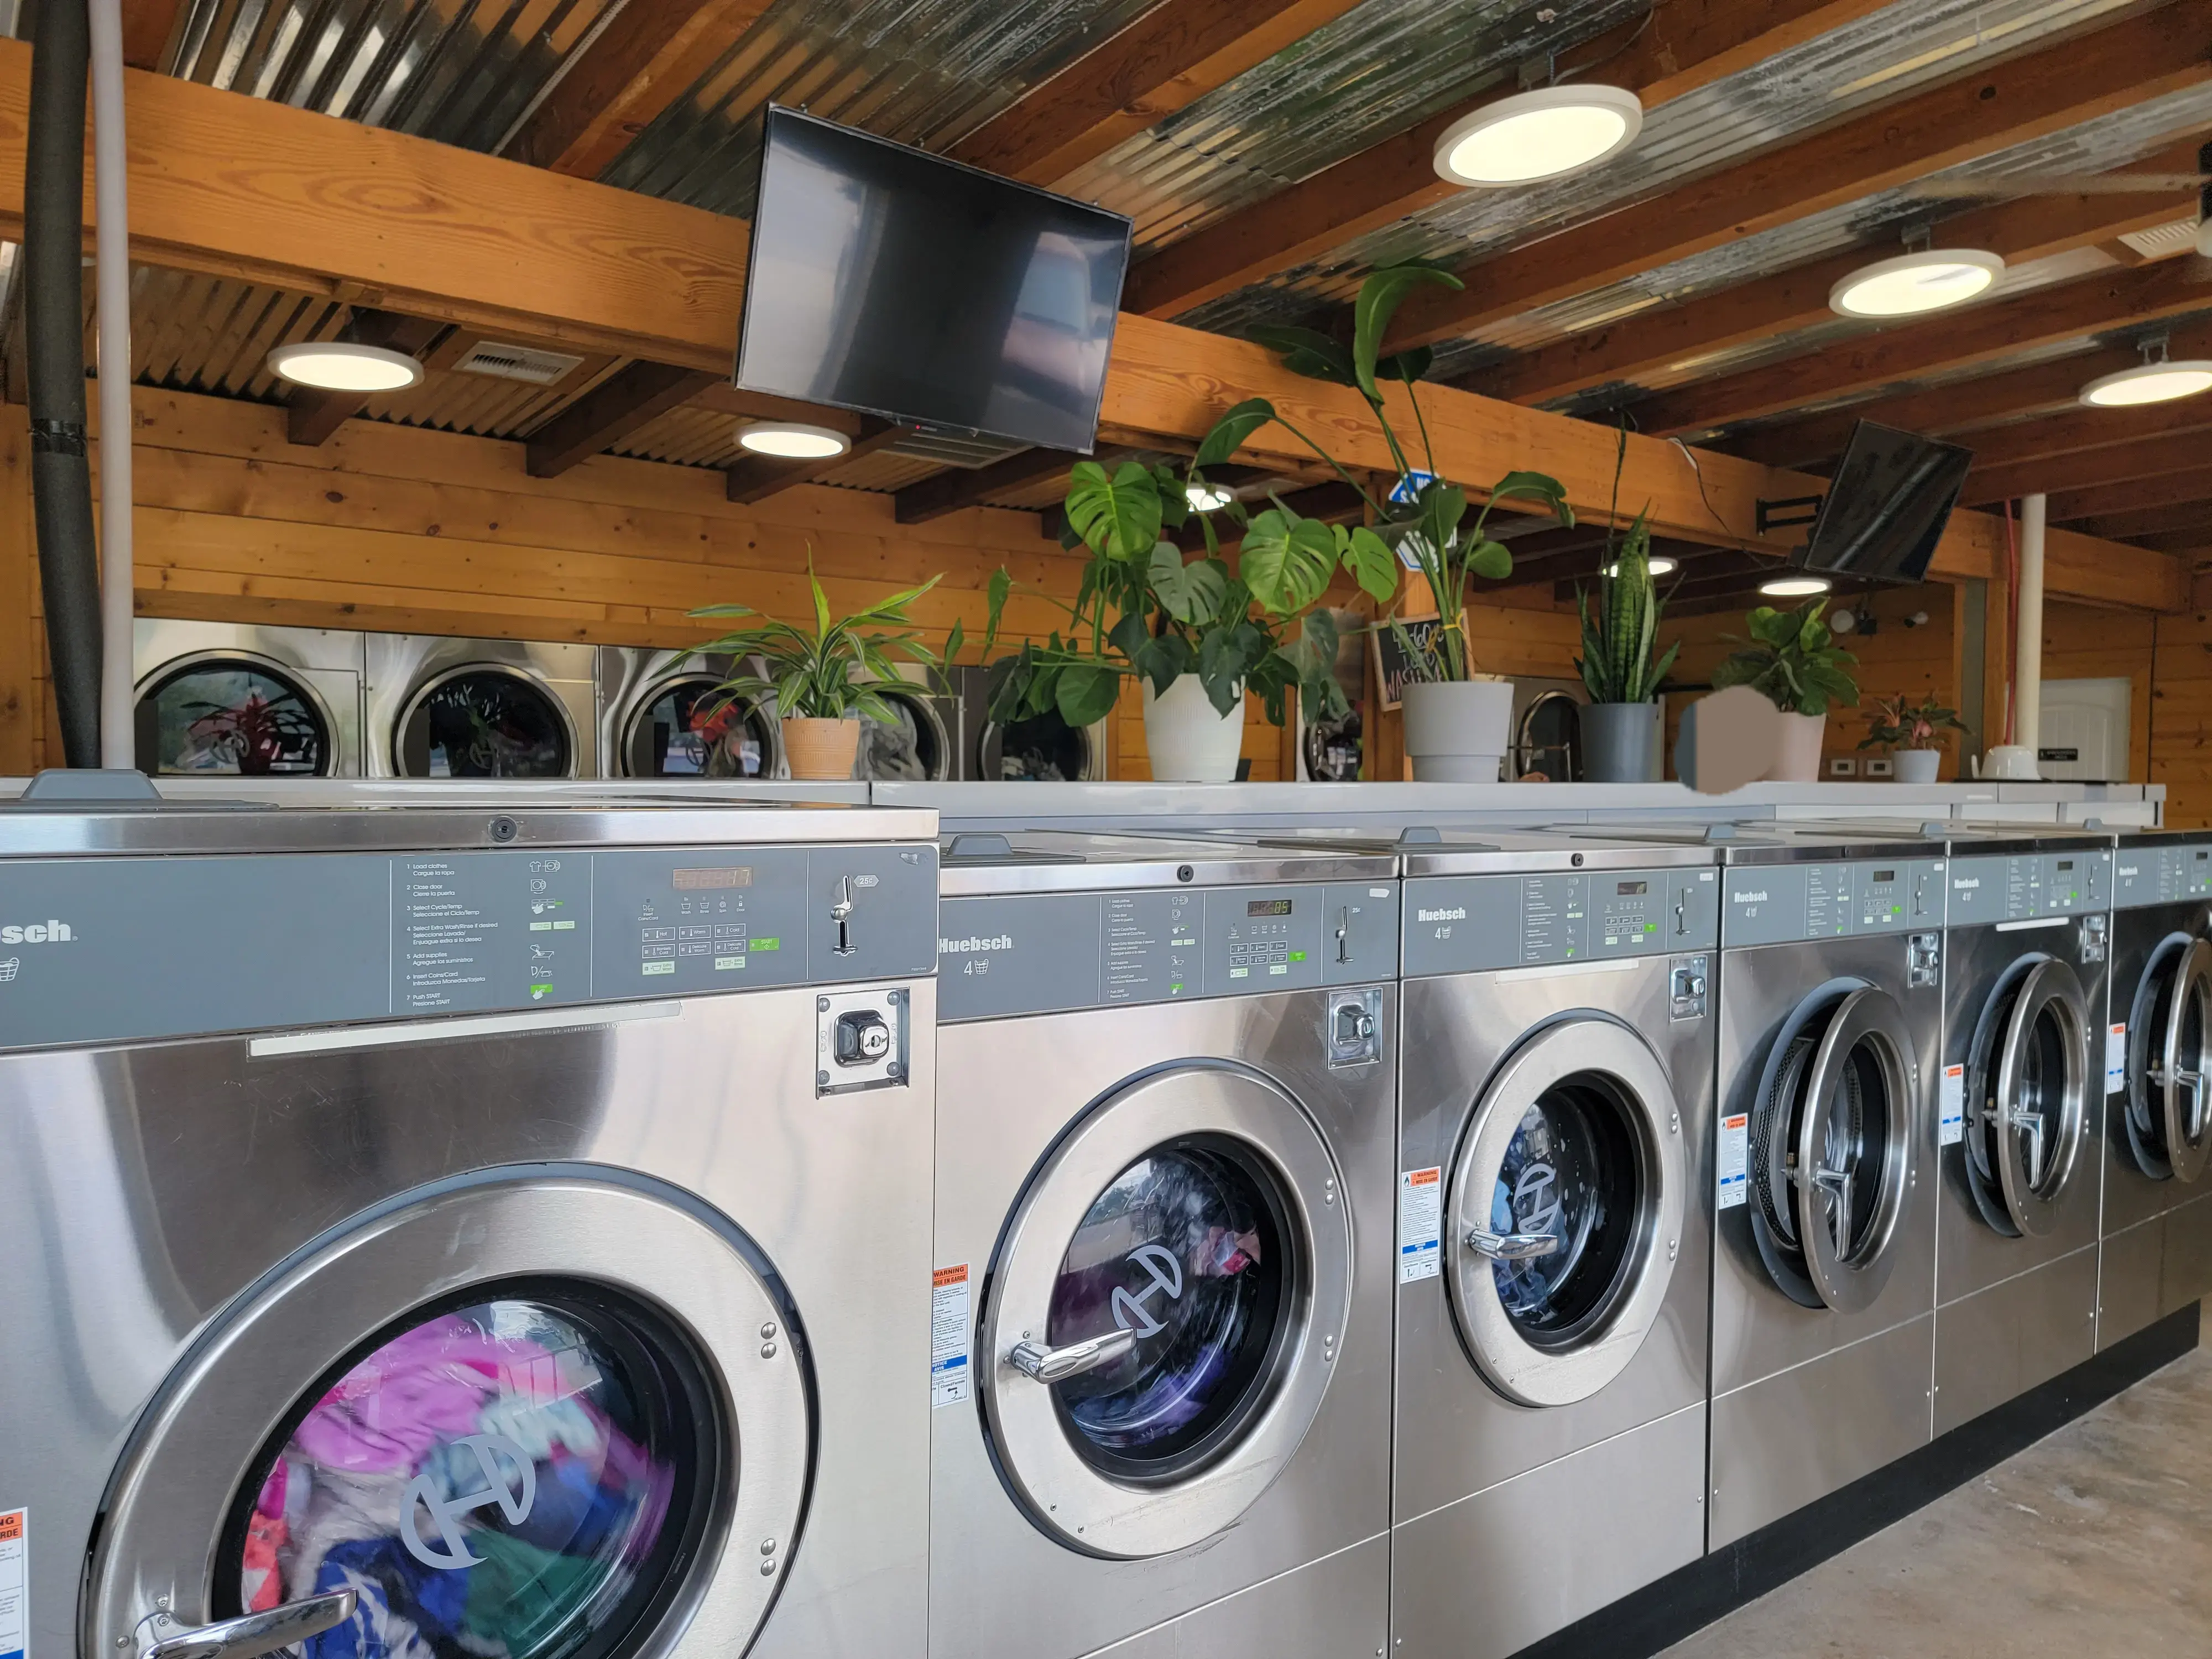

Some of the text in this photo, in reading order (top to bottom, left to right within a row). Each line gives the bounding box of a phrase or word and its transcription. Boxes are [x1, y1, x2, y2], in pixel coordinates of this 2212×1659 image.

[1418, 907, 1465, 922] Huebsch
[0, 920, 71, 944] sch
[1435, 927, 1441, 940] 4
[939, 935, 1012, 953] Huebsch
[964, 961, 973, 975] 4
[933, 1267, 964, 1277] WARNING
